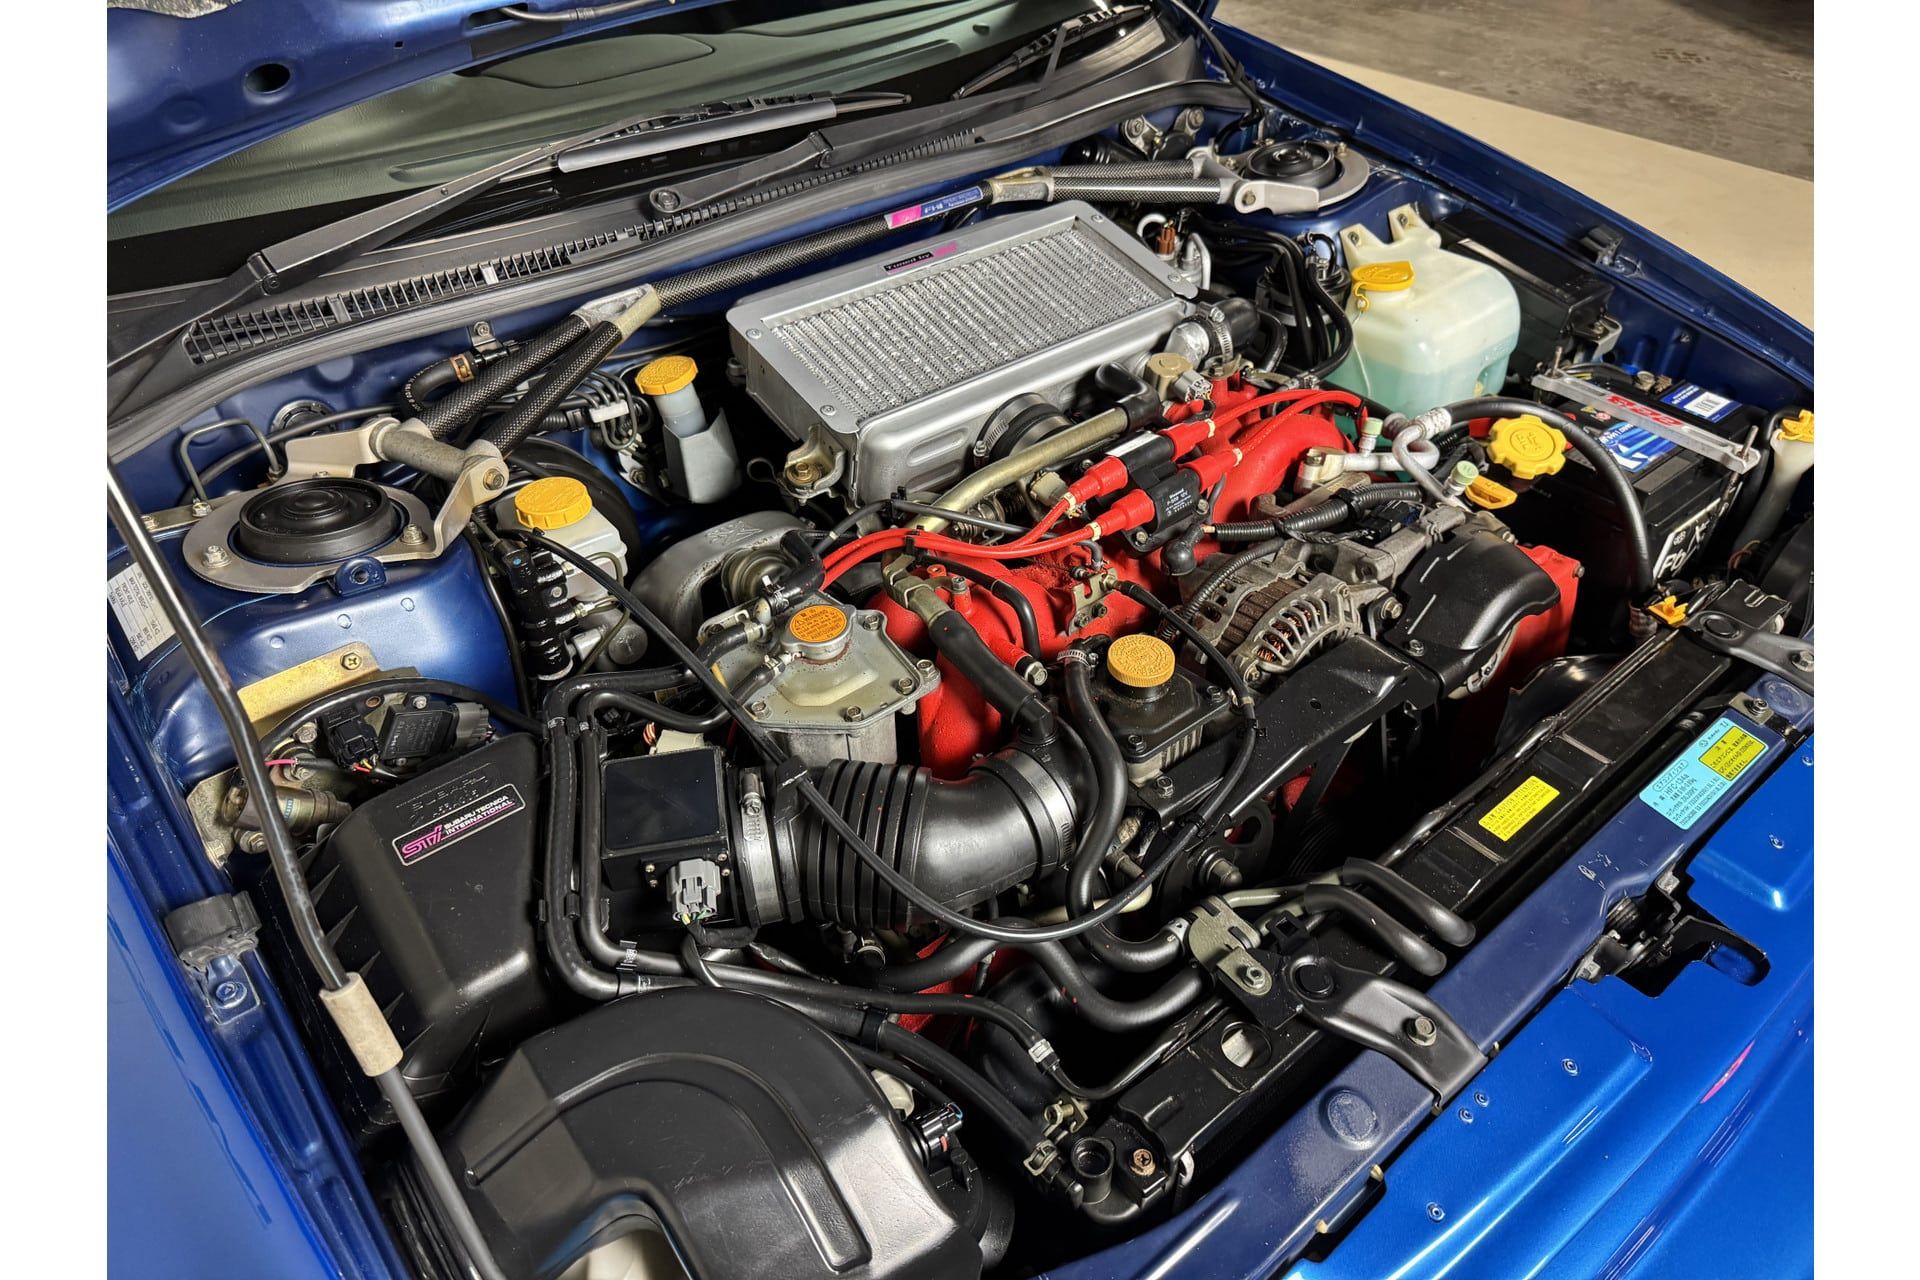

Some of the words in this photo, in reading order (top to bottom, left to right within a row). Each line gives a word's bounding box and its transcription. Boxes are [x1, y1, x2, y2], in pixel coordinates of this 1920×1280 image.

[444, 812, 476, 829] SUBARU
[477, 795, 508, 814] TECNICA
[445, 801, 513, 835] INTERNATIONAL
